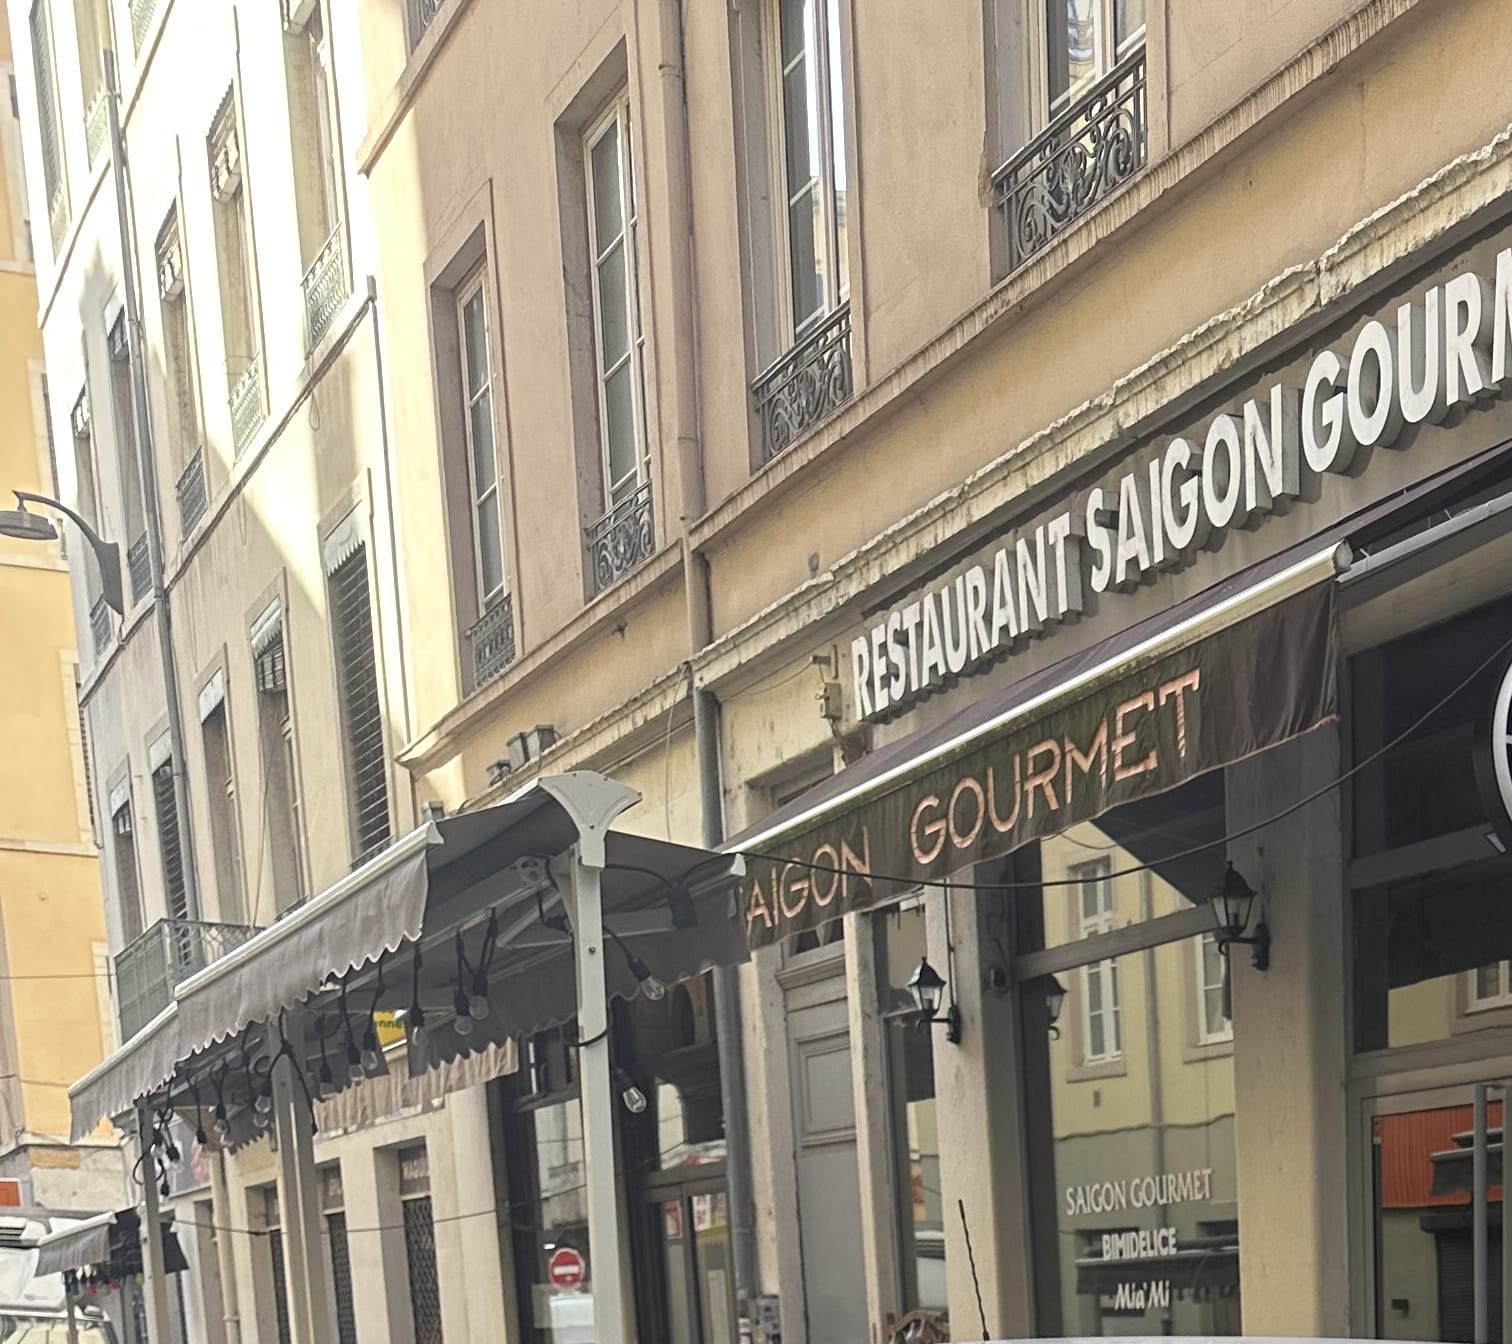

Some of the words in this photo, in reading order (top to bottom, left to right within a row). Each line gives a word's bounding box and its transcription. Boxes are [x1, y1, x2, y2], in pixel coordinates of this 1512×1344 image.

[852, 511, 1078, 722] RESTAURANT
[1085, 382, 1292, 594] SAIGON
[738, 824, 873, 936] AIGON
[910, 667, 1200, 865] GOURMET
[1065, 1180, 1126, 1216] SAIGON
[1130, 1168, 1213, 1208] GOURMET
[1102, 1227, 1178, 1261] BIMIDELICE
